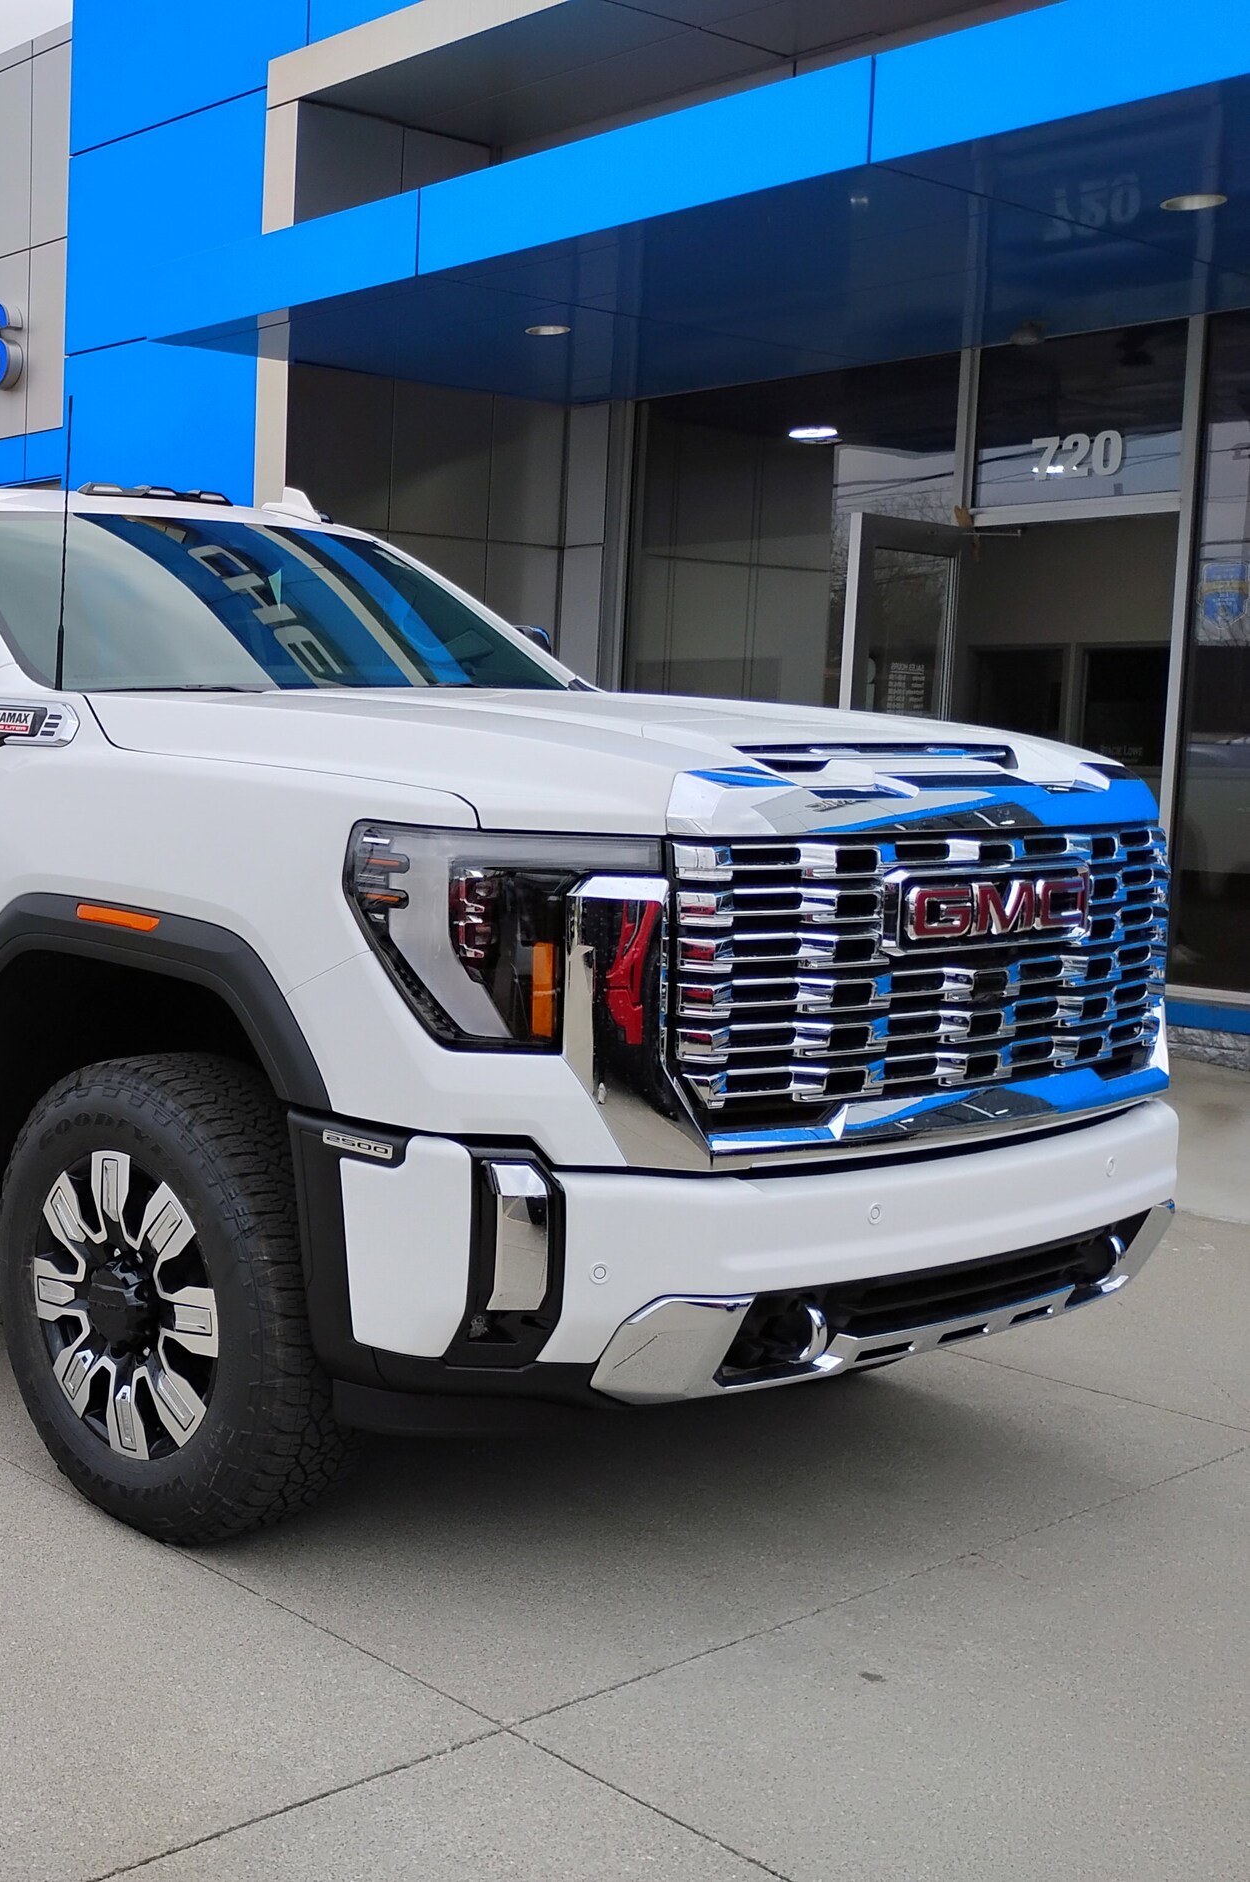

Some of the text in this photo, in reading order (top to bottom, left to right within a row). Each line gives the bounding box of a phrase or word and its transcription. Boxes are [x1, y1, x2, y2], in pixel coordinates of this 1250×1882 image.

[1031, 429, 1123, 481] 720
[905, 880, 1085, 939] GMC
[326, 1134, 389, 1155] 2500
